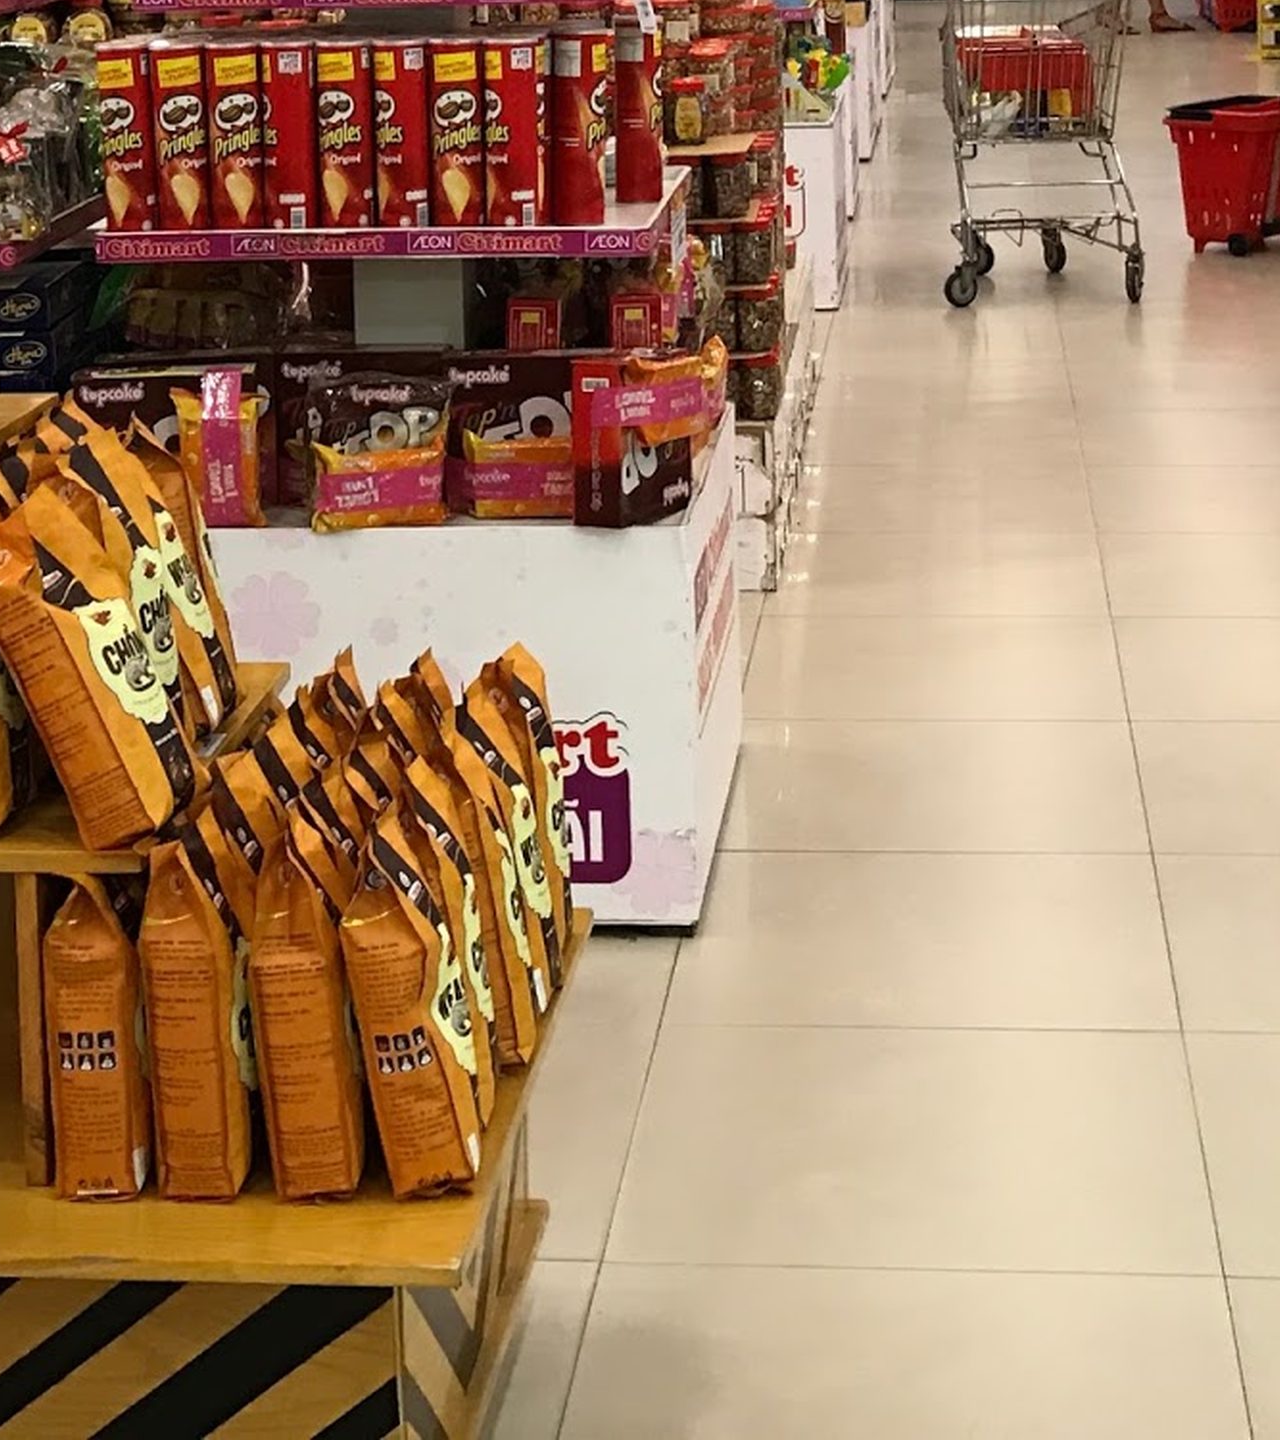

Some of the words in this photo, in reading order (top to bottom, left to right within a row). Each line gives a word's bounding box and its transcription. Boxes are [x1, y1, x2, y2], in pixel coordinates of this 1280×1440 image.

[105, 236, 211, 258] Citimart
[280, 234, 386, 257] Citimart
[456, 231, 563, 253] Citimart
